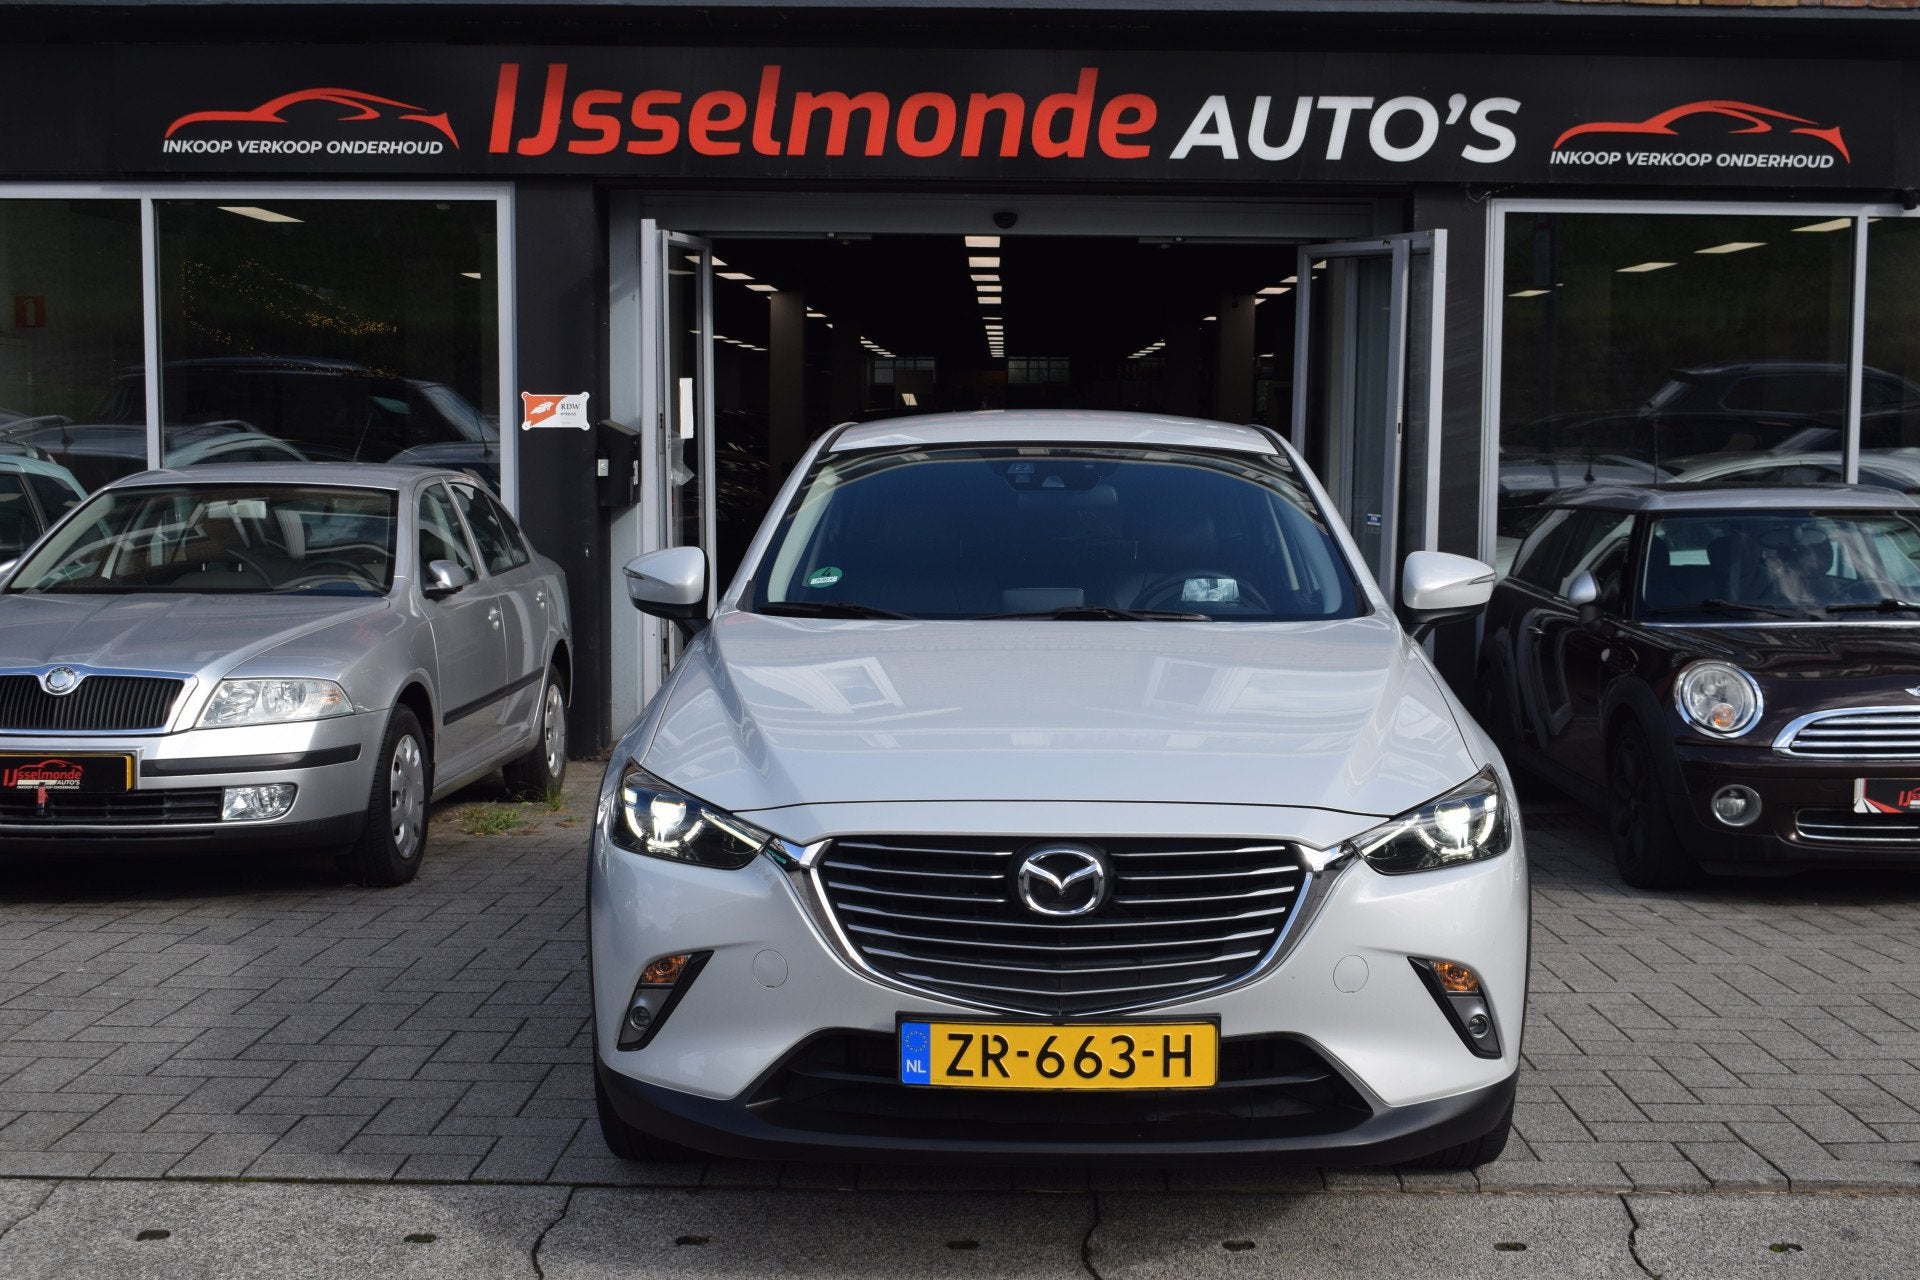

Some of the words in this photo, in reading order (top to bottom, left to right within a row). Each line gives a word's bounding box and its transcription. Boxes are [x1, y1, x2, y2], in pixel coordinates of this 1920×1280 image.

[489, 63, 1158, 160] IJsselmonde
[1169, 93, 1522, 164] AUTO'S
[162, 140, 233, 154] INKOOP
[237, 140, 323, 155] VERKOOP
[326, 140, 444, 155] ONDERHOUD
[1550, 151, 1621, 165] INKOOP
[1626, 152, 1713, 167] VERKOOP
[1716, 153, 1834, 169] ONDERHOUD
[3, 768, 82, 787] IJsselmonde
[946, 1033, 1192, 1079] ZR-663-H
[906, 1059, 927, 1073] NL
